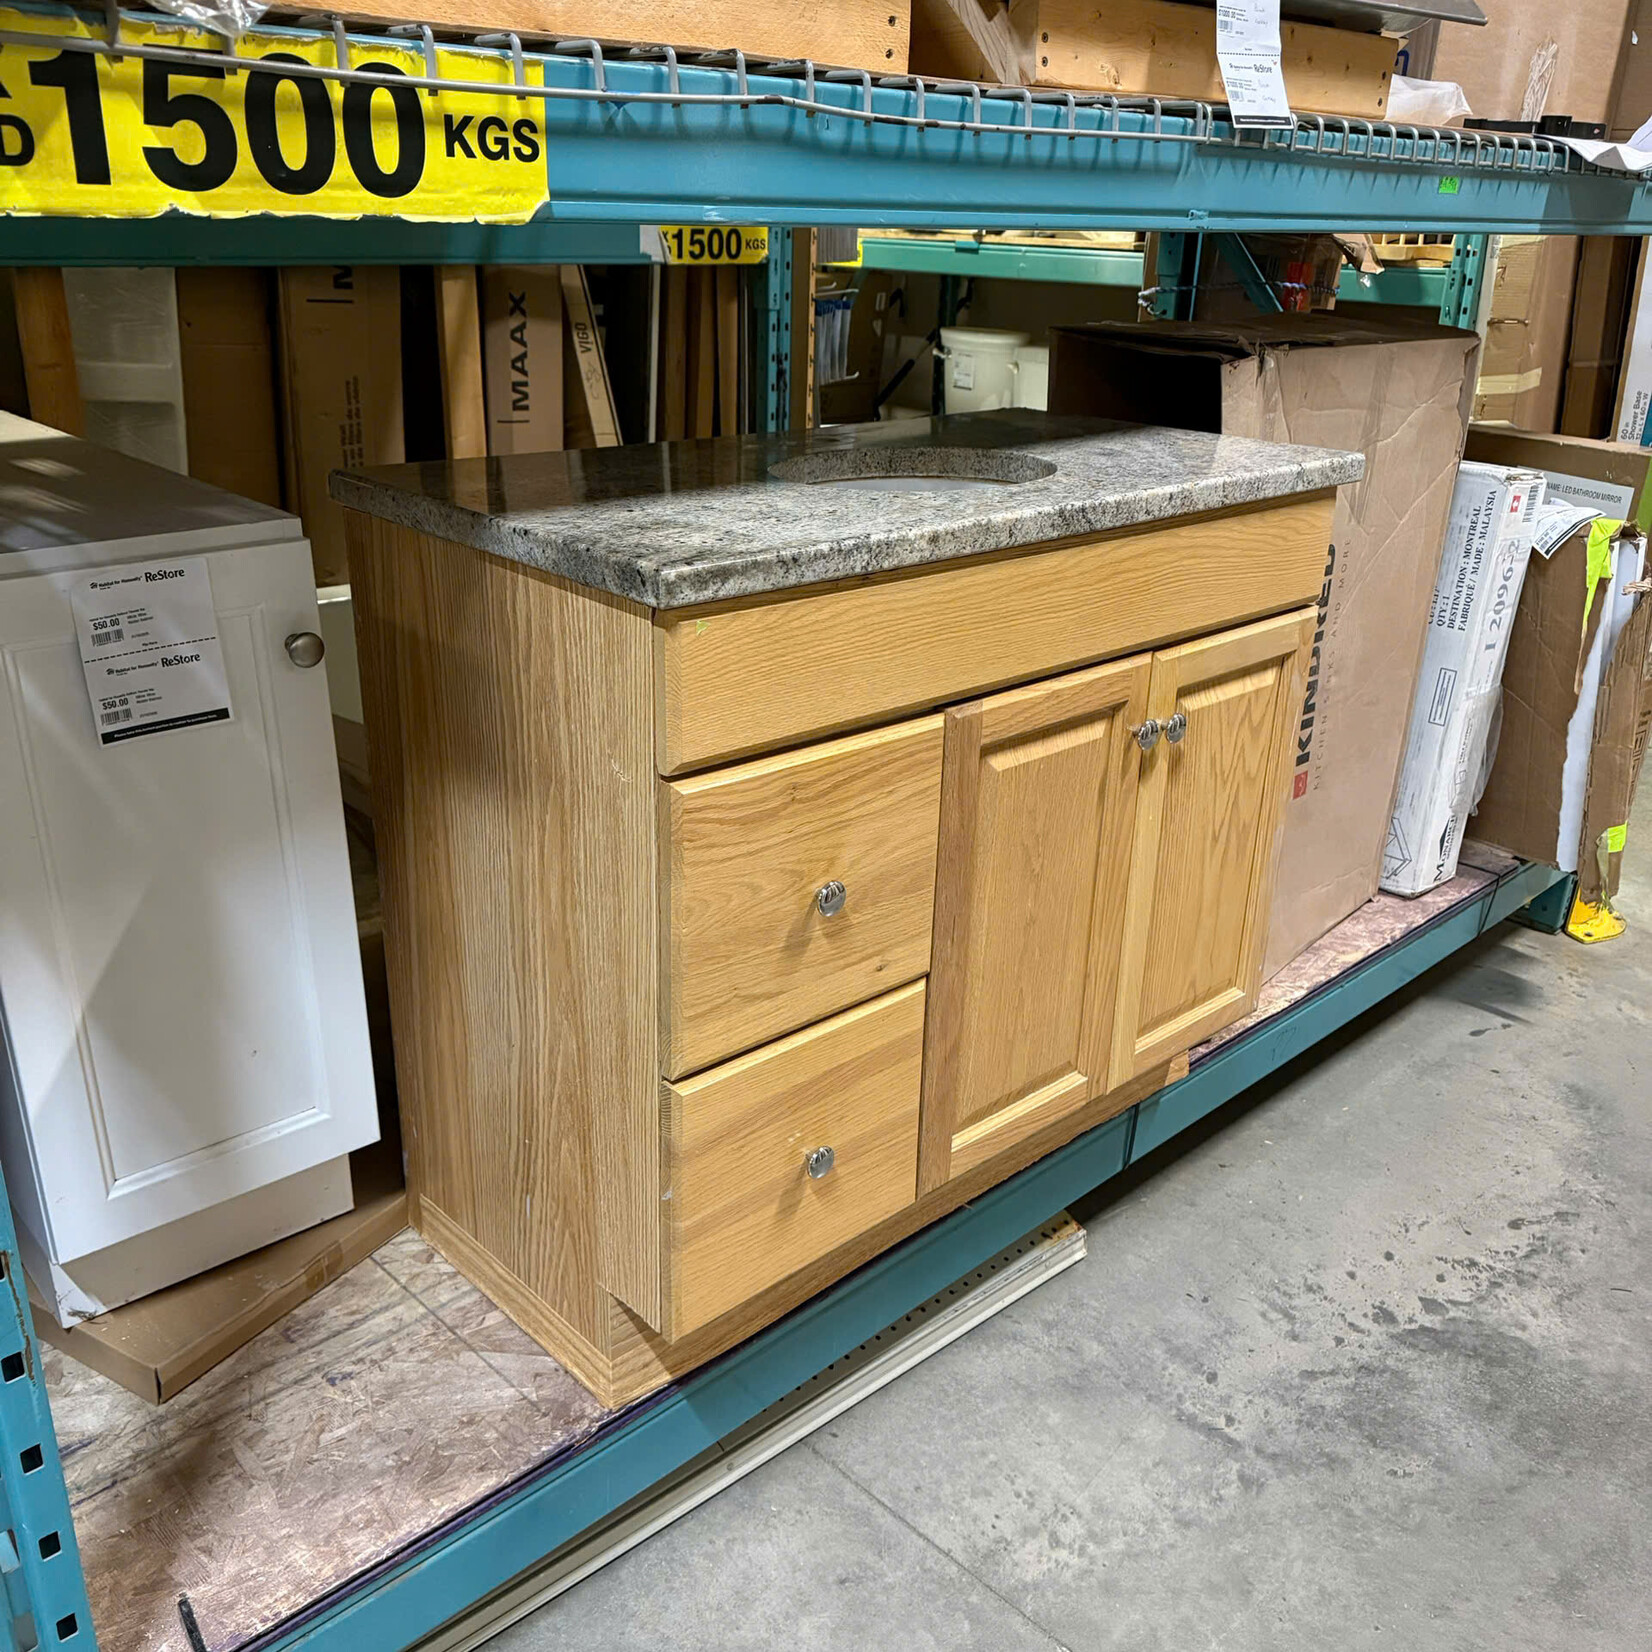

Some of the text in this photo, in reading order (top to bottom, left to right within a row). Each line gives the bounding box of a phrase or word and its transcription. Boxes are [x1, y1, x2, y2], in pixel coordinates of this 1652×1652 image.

[28, 44, 541, 198] 1500 KGS
[672, 228, 742, 260] 1500
[745, 238, 766, 251] KGS
[508, 291, 530, 412] MAAX
[574, 322, 594, 354] VIGO
[1628, 390, 1643, 440] Shower Base
[1621, 429, 1628, 440] 60
[1562, 485, 1573, 496] LED
[1573, 487, 1601, 501] BATHROOM
[1600, 492, 1623, 504] MIRROR
[144, 569, 186, 583] ReStore
[1447, 566, 1467, 629] DESTINATION
[1463, 505, 1482, 560] MONTREAL
[1457, 583, 1476, 631] FABRIQUÉ
[1472, 548, 1484, 576] MADE
[1479, 489, 1497, 541] MALAYSIA
[92, 618, 120, 631] $50.00
[1436, 607, 1448, 627] QTY
[161, 653, 201, 668] ReStore
[1296, 544, 1336, 767] KINDRED
[1313, 539, 1351, 790] KITCHEN SNKS AND MORE
[102, 698, 129, 711] $50.00
